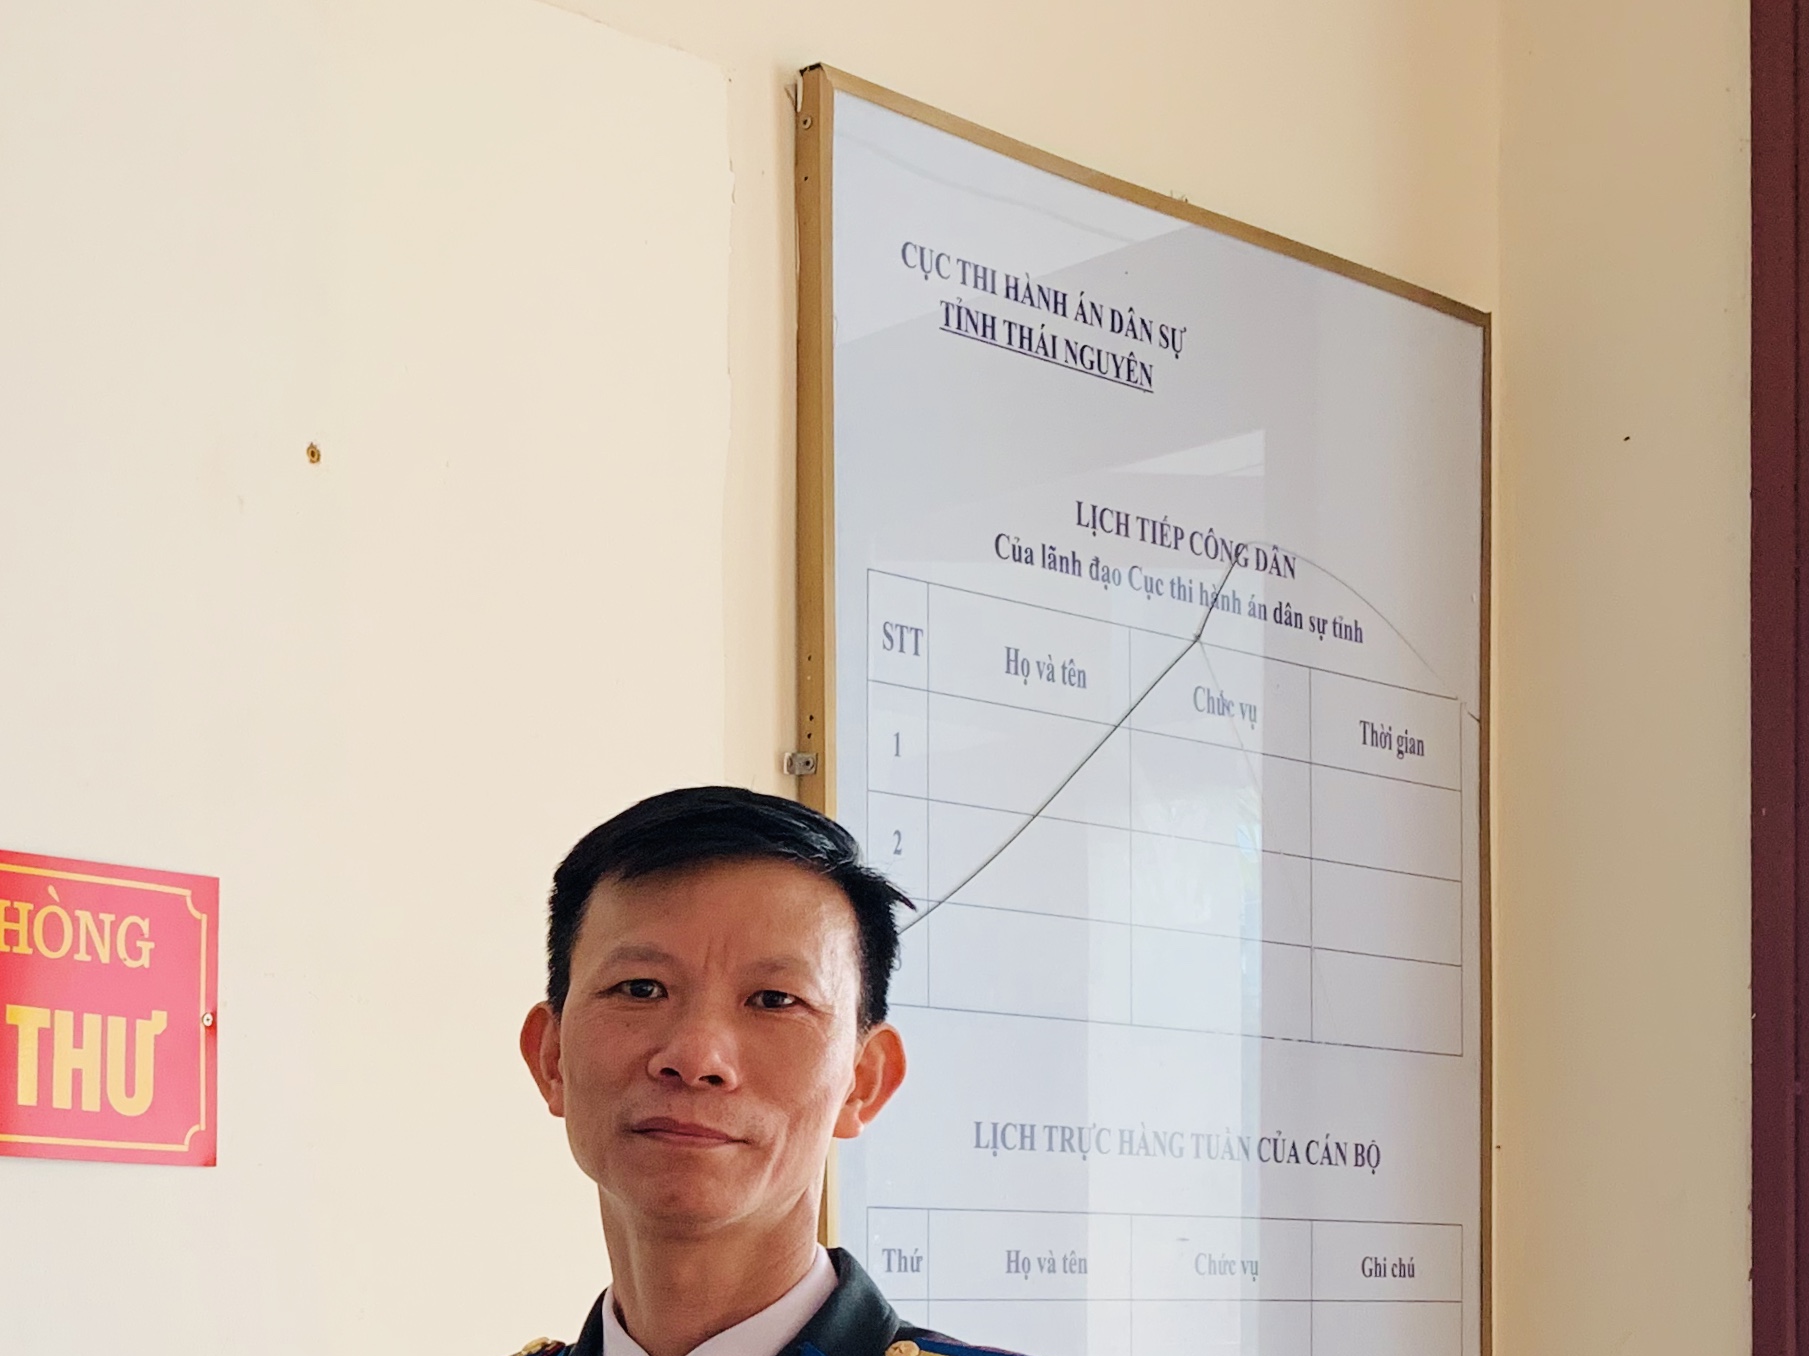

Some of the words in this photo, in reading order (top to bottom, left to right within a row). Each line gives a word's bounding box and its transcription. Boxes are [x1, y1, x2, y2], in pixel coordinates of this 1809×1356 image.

[901, 242, 951, 281] CỤC
[956, 258, 997, 295] THI
[1004, 273, 1068, 317] HÀNH
[1074, 291, 1103, 327] ÁN
[1109, 308, 1153, 345] DÂN
[1158, 323, 1187, 359] SỰ
[939, 297, 997, 341] TỈNH
[1003, 319, 1058, 360] THÁI
[1064, 340, 1153, 388] NGUYÊN
[1075, 500, 1130, 537] LỊCH
[1136, 515, 1184, 550] TIẾP
[1189, 527, 1249, 568] CÔNG
[1255, 545, 1296, 579] DÂN
[994, 533, 1034, 566] Của
[1041, 543, 1082, 577] lãnh
[1089, 556, 1121, 590] đạo
[1128, 565, 1164, 600] Cục
[1170, 576, 1193, 603] thi
[1199, 582, 1242, 615] hành
[1248, 594, 1268, 621] án
[1273, 601, 1303, 630] dân
[1309, 615, 1328, 641] sự
[1332, 615, 1364, 643] tỉnh
[882, 621, 924, 657] STT
[1004, 646, 1030, 686] Họ
[1036, 654, 1056, 683] và
[1061, 658, 1087, 689] tên
[1193, 685, 1235, 718] Chức
[1239, 702, 1257, 730] vụ
[893, 732, 901, 757] 1
[1359, 719, 1392, 750] Thời
[1396, 729, 1425, 760] gian
[893, 829, 902, 855] 2
[5, 1004, 168, 1117] THƯ
[973, 1121, 1037, 1157] LỊCH
[1043, 1122, 1111, 1161] TRỰC
[1117, 1121, 1185, 1159] HÀNG
[1257, 1129, 1301, 1164] CỦA
[1305, 1132, 1348, 1167] CÁN
[1353, 1139, 1381, 1175] BỘ
[882, 1247, 923, 1273] Thứ
[1005, 1250, 1031, 1280] Họ
[1037, 1250, 1056, 1274] và
[1062, 1250, 1088, 1274] tên
[1194, 1252, 1236, 1276] Chức
[1241, 1260, 1259, 1282] vụ
[1361, 1256, 1387, 1278] Ghi
[1391, 1256, 1415, 1278] chú
